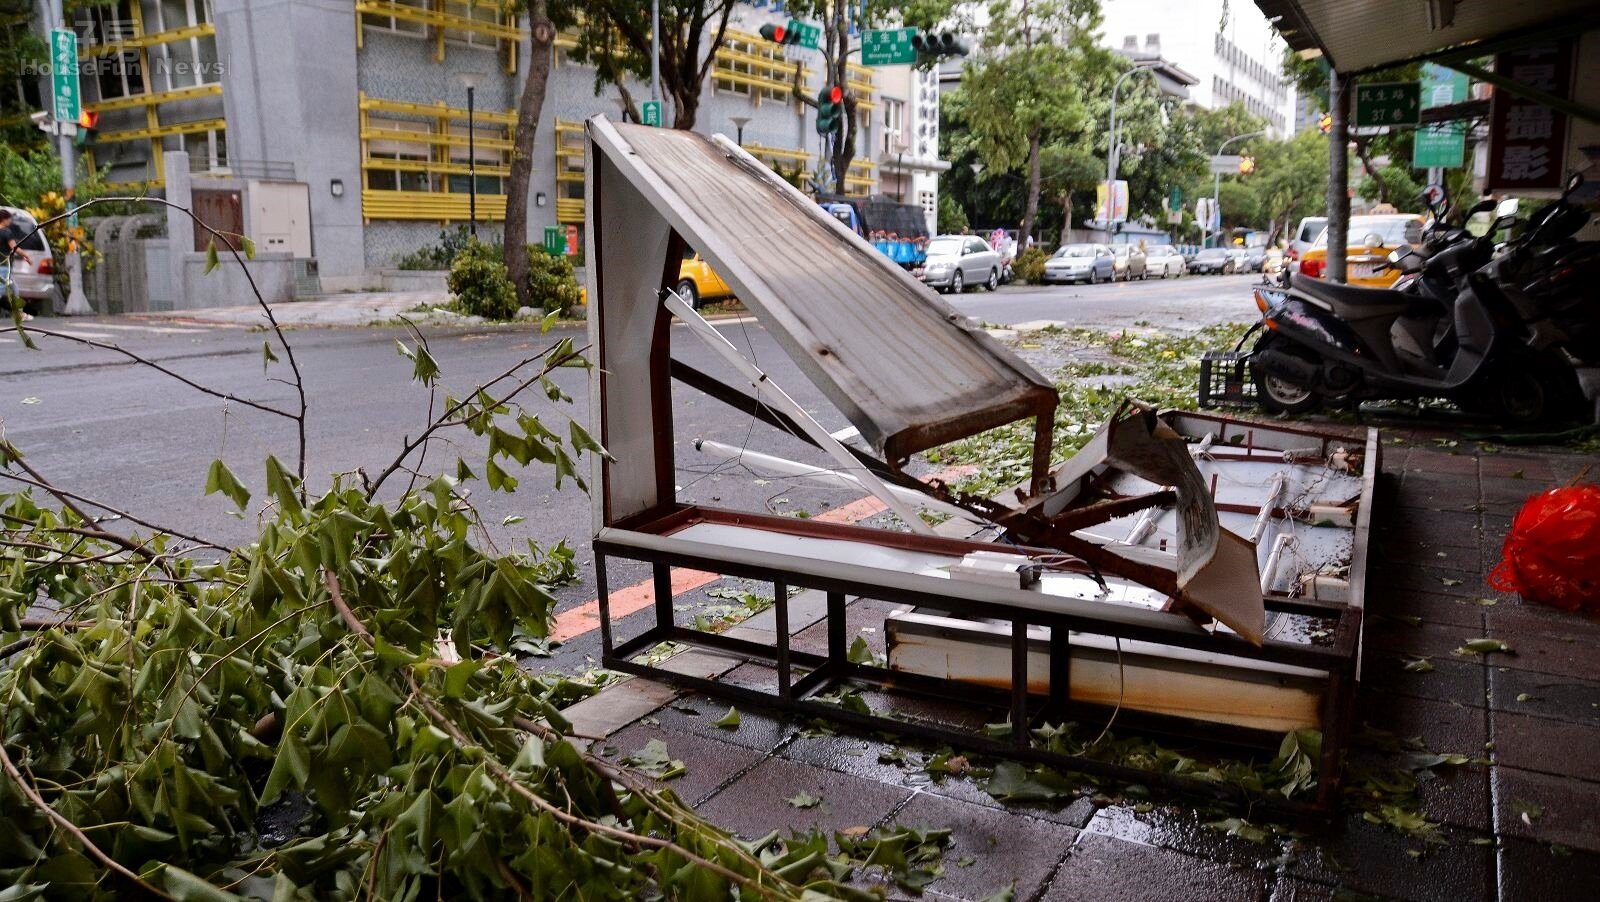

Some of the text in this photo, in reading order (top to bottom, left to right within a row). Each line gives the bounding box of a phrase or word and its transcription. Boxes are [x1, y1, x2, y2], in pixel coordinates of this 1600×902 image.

[863, 30, 907, 44] 民生路
[1361, 89, 1405, 102] 民生路
